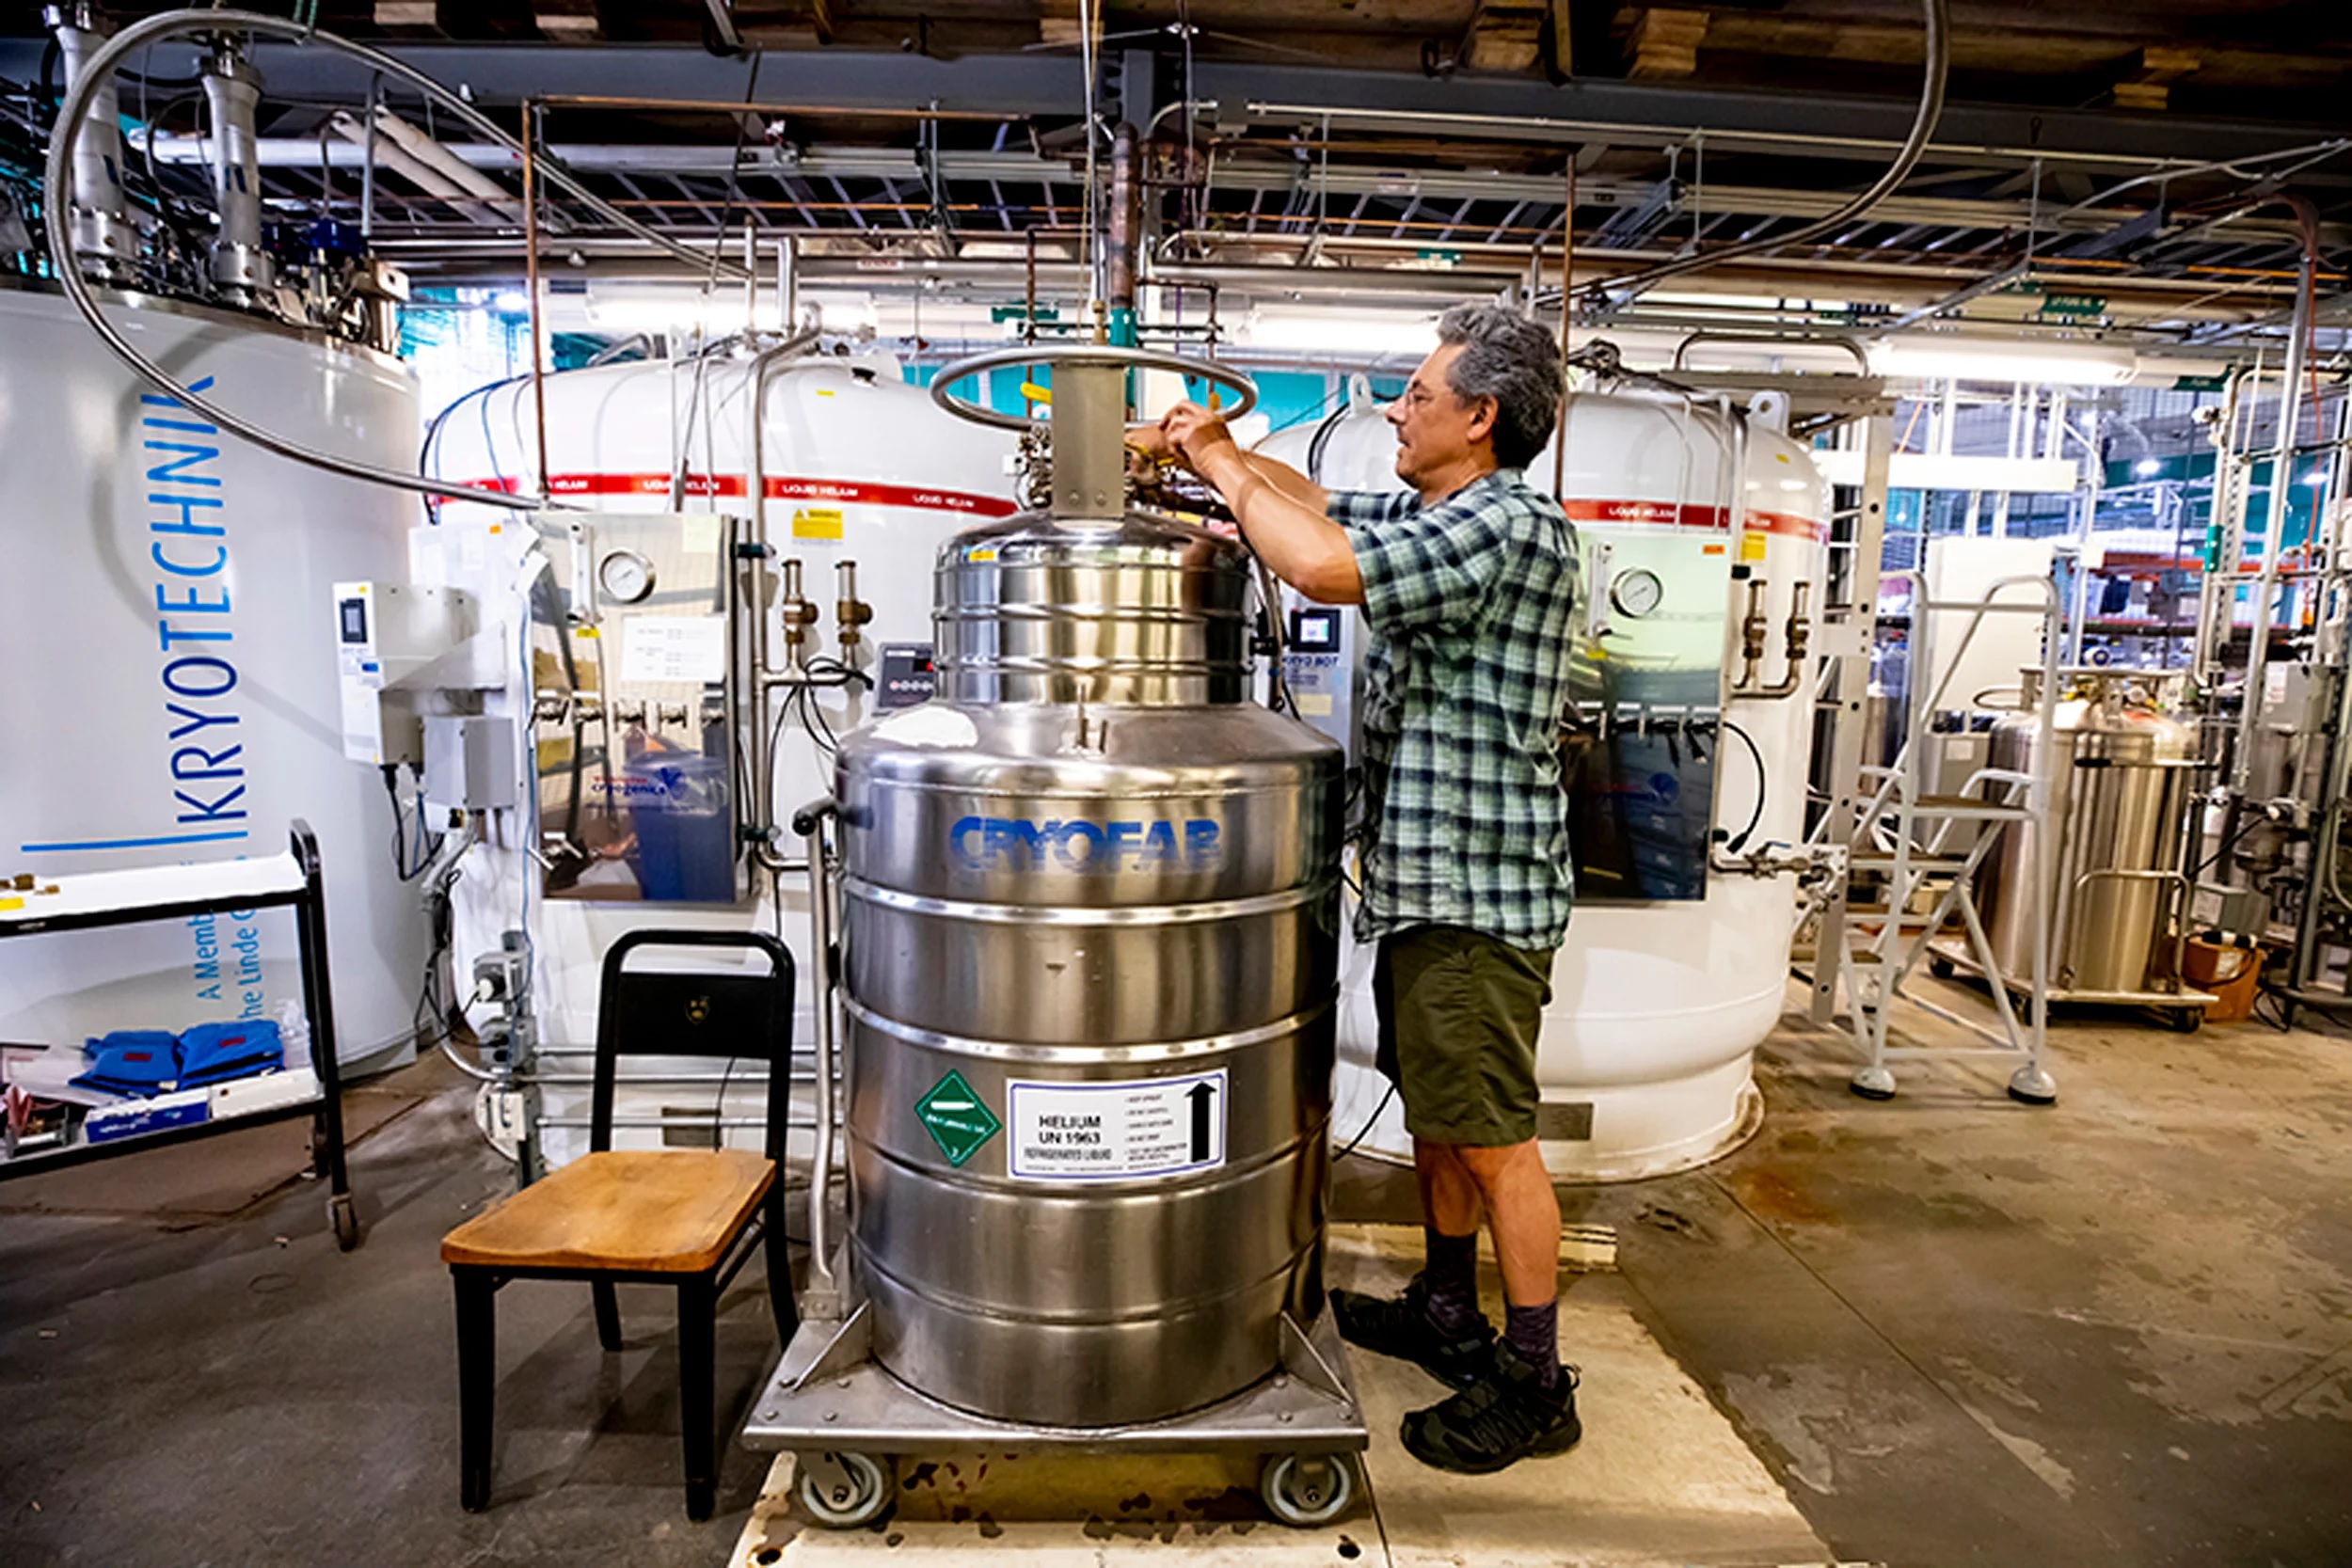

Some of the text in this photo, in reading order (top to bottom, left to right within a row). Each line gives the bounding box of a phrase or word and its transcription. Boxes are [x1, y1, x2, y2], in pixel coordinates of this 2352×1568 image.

[140, 375, 247, 823] KRYOTECHNIK
[949, 816, 1222, 874] CRYOFAB
[230, 927, 263, 986] Linde
[197, 983, 222, 1000] A
[237, 990, 264, 1021] he
[1038, 1115, 1102, 1130] HELIUM
[1038, 1132, 1102, 1146] UN 1963
